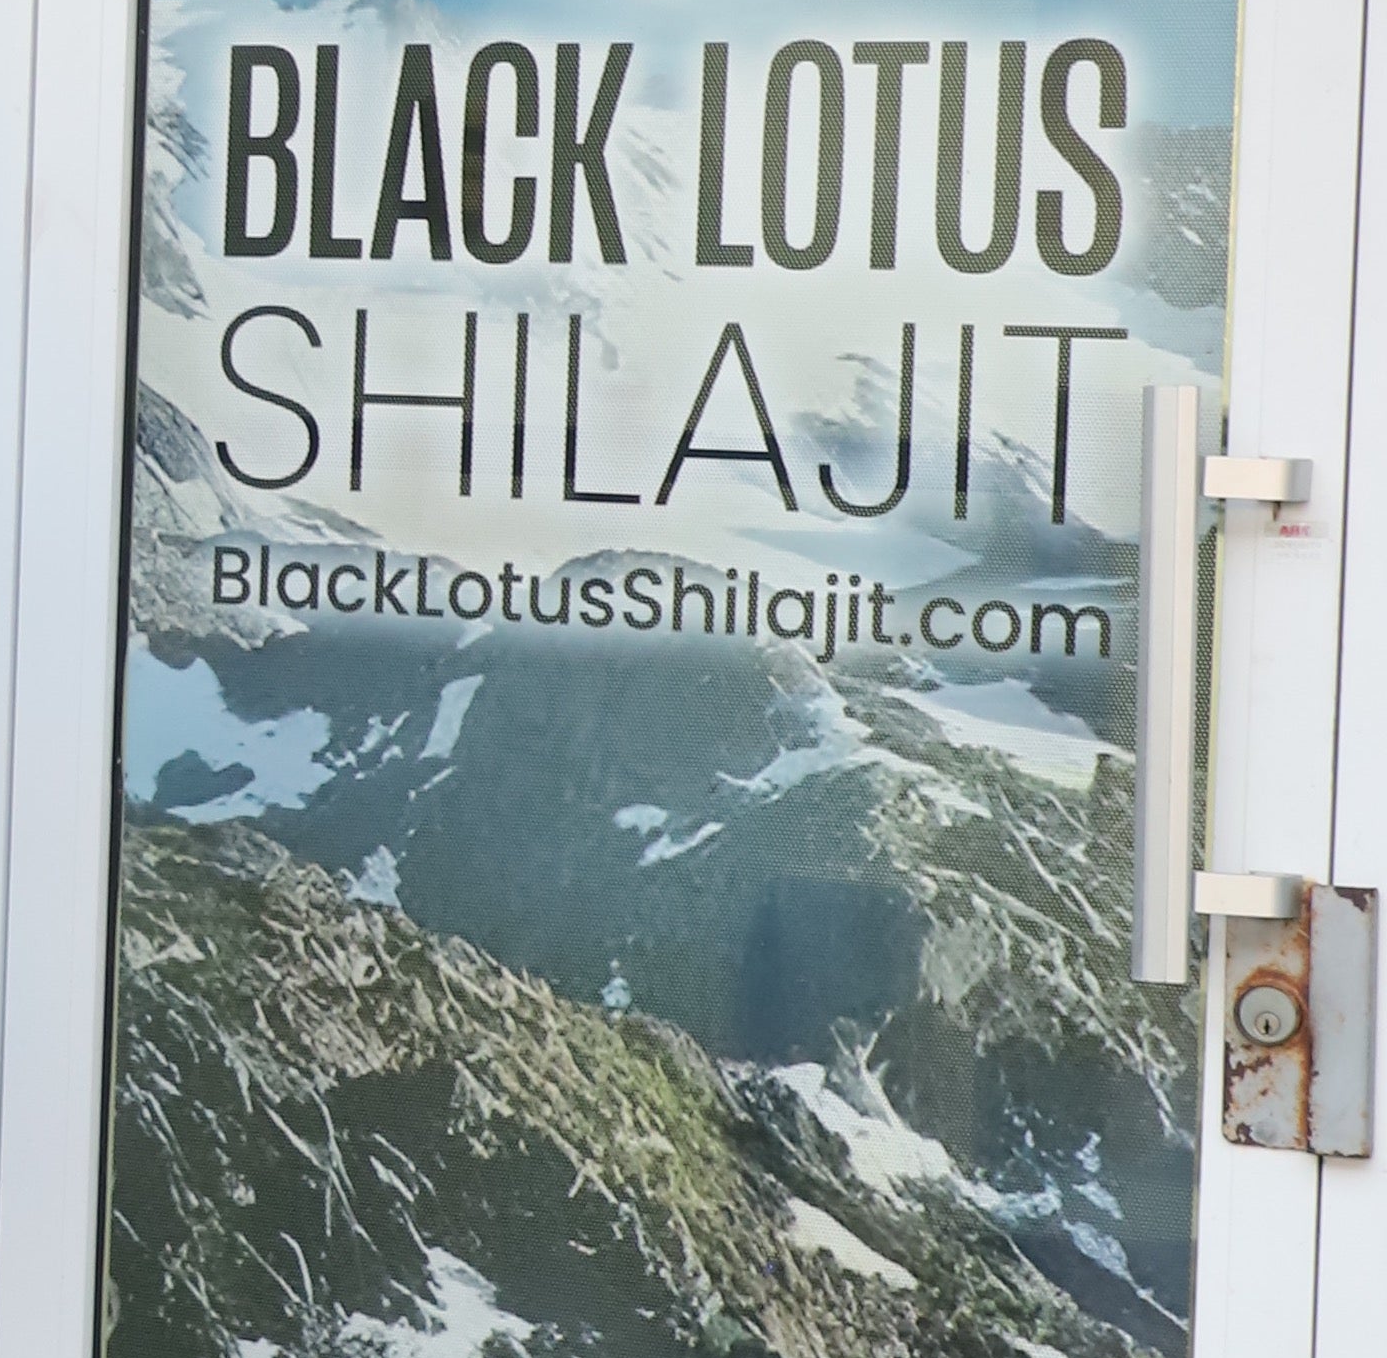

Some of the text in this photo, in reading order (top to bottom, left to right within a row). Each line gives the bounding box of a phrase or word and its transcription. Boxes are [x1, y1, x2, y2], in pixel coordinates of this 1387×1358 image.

[224, 38, 1127, 276] BLACK LOTUS
[214, 304, 1130, 525] SHILAJIT
[212, 543, 1113, 665] BlackLotusShilajit.com
